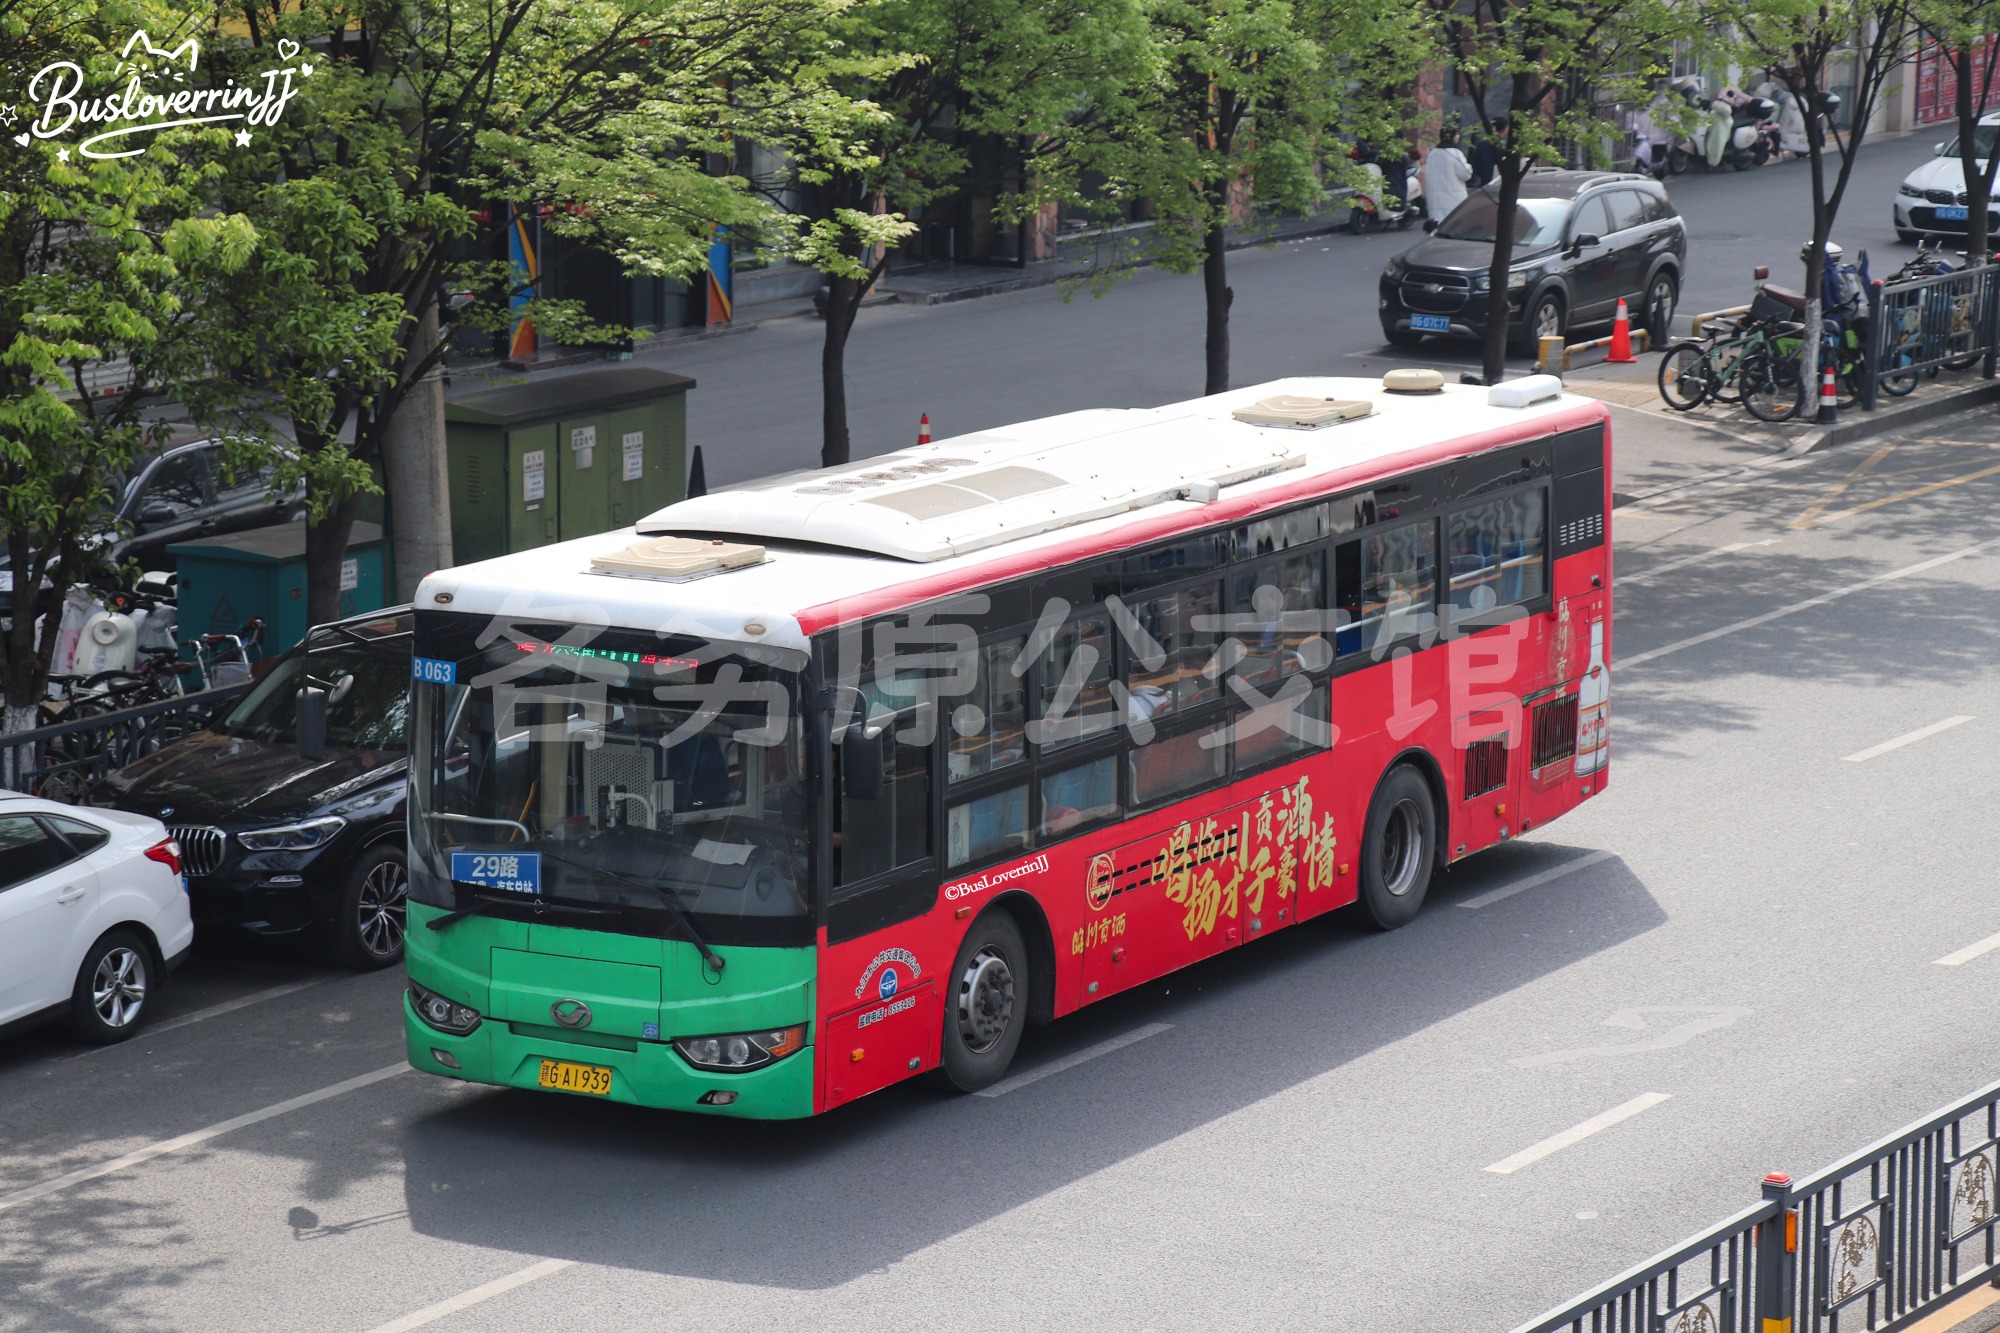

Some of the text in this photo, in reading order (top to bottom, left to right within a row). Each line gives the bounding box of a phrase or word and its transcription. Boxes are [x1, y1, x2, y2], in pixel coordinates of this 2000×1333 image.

[414, 658, 451, 682] B 063
[471, 856, 519, 878] 29路
